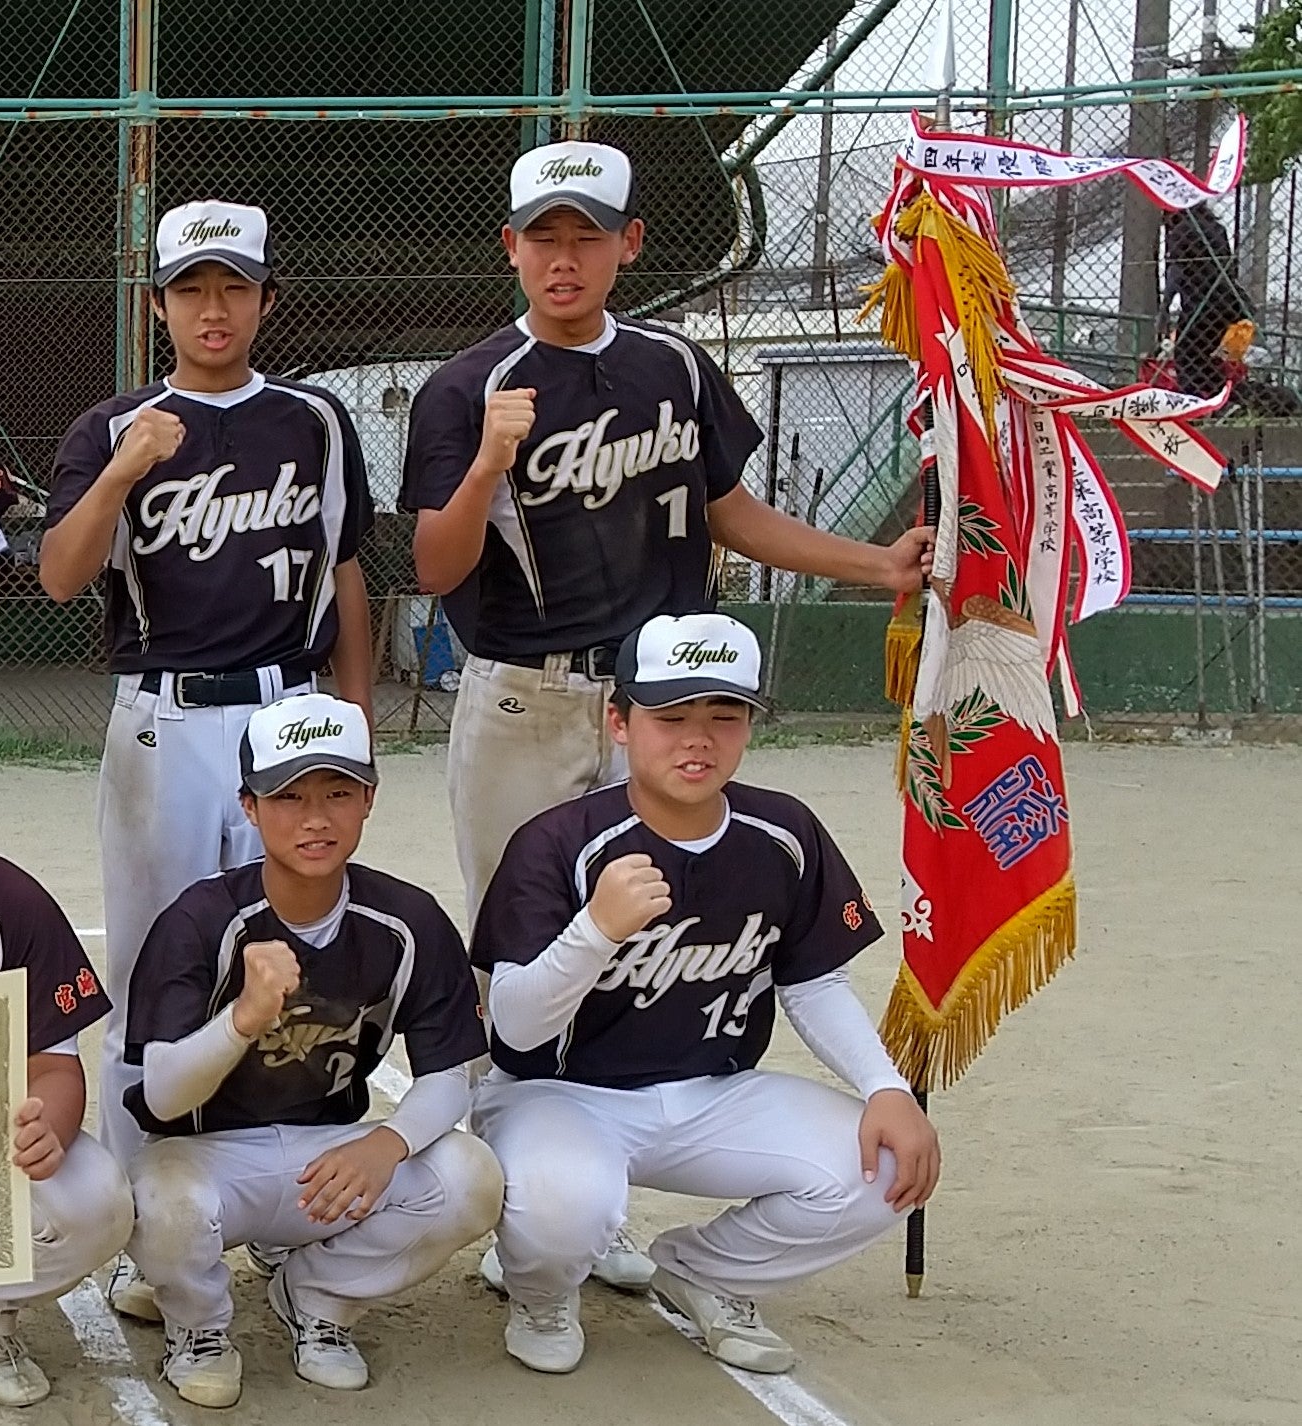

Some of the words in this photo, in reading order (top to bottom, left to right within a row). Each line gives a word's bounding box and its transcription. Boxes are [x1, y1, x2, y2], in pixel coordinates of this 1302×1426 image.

[536, 157, 603, 186] Hyuko
[177, 221, 241, 246] Hyuko
[521, 400, 700, 510] Hyuko
[134, 463, 320, 562] Hyuko
[656, 486, 689, 539] 1
[257, 547, 315, 602] 17
[667, 639, 740, 671] Hyuko
[275, 716, 344, 751] Hyuko
